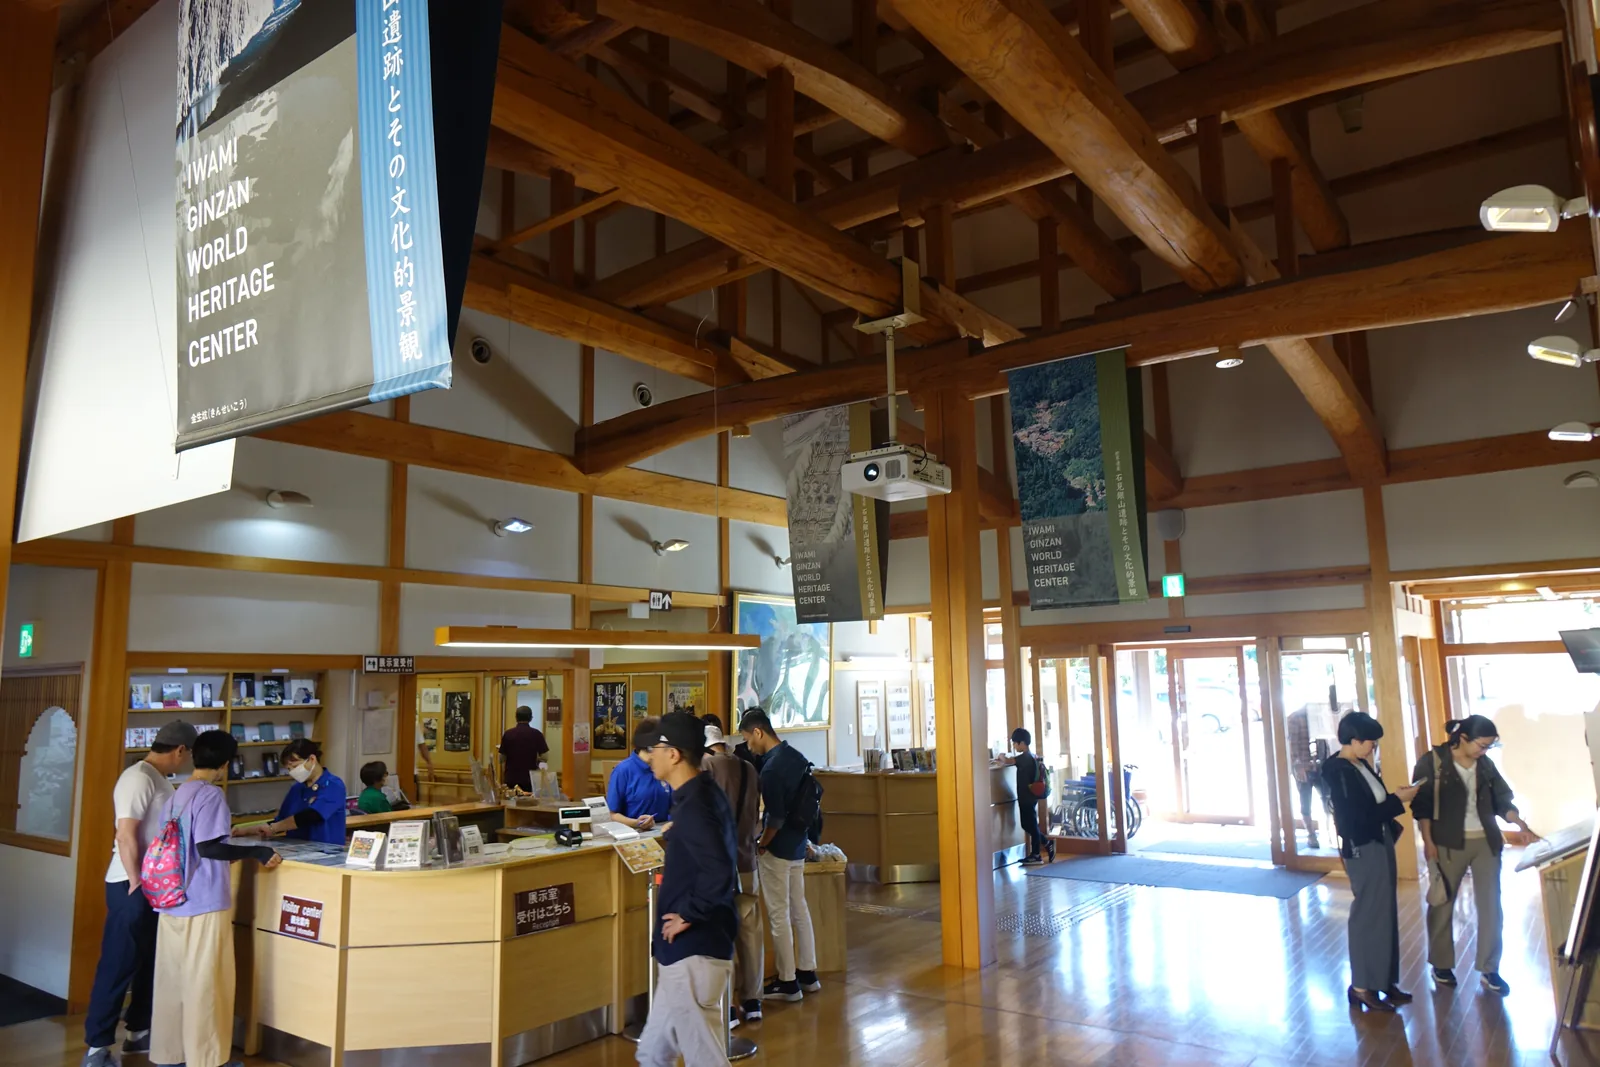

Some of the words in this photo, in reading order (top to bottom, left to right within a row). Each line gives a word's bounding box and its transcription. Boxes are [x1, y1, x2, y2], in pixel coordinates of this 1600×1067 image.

[187, 137, 238, 189] IWAMI
[187, 176, 250, 232] GINZAN
[186, 226, 248, 277] WORLD
[188, 261, 276, 323] HERITAGE
[188, 318, 259, 368] CENTER
[1028, 524, 1055, 536] IWAMI
[1030, 537, 1062, 549] GINZAN
[795, 550, 816, 559] IWAMI
[1031, 550, 1062, 562] WORLD
[796, 561, 821, 571] GINZAN
[1032, 562, 1076, 575] HERITAGE
[796, 573, 821, 582] WORLD
[1034, 576, 1069, 588] CENTER
[798, 583, 831, 593] HERITAGE
[799, 595, 826, 605] CENTER
[528, 887, 559, 905] 展示室
[517, 902, 571, 925] 受付はこちら
